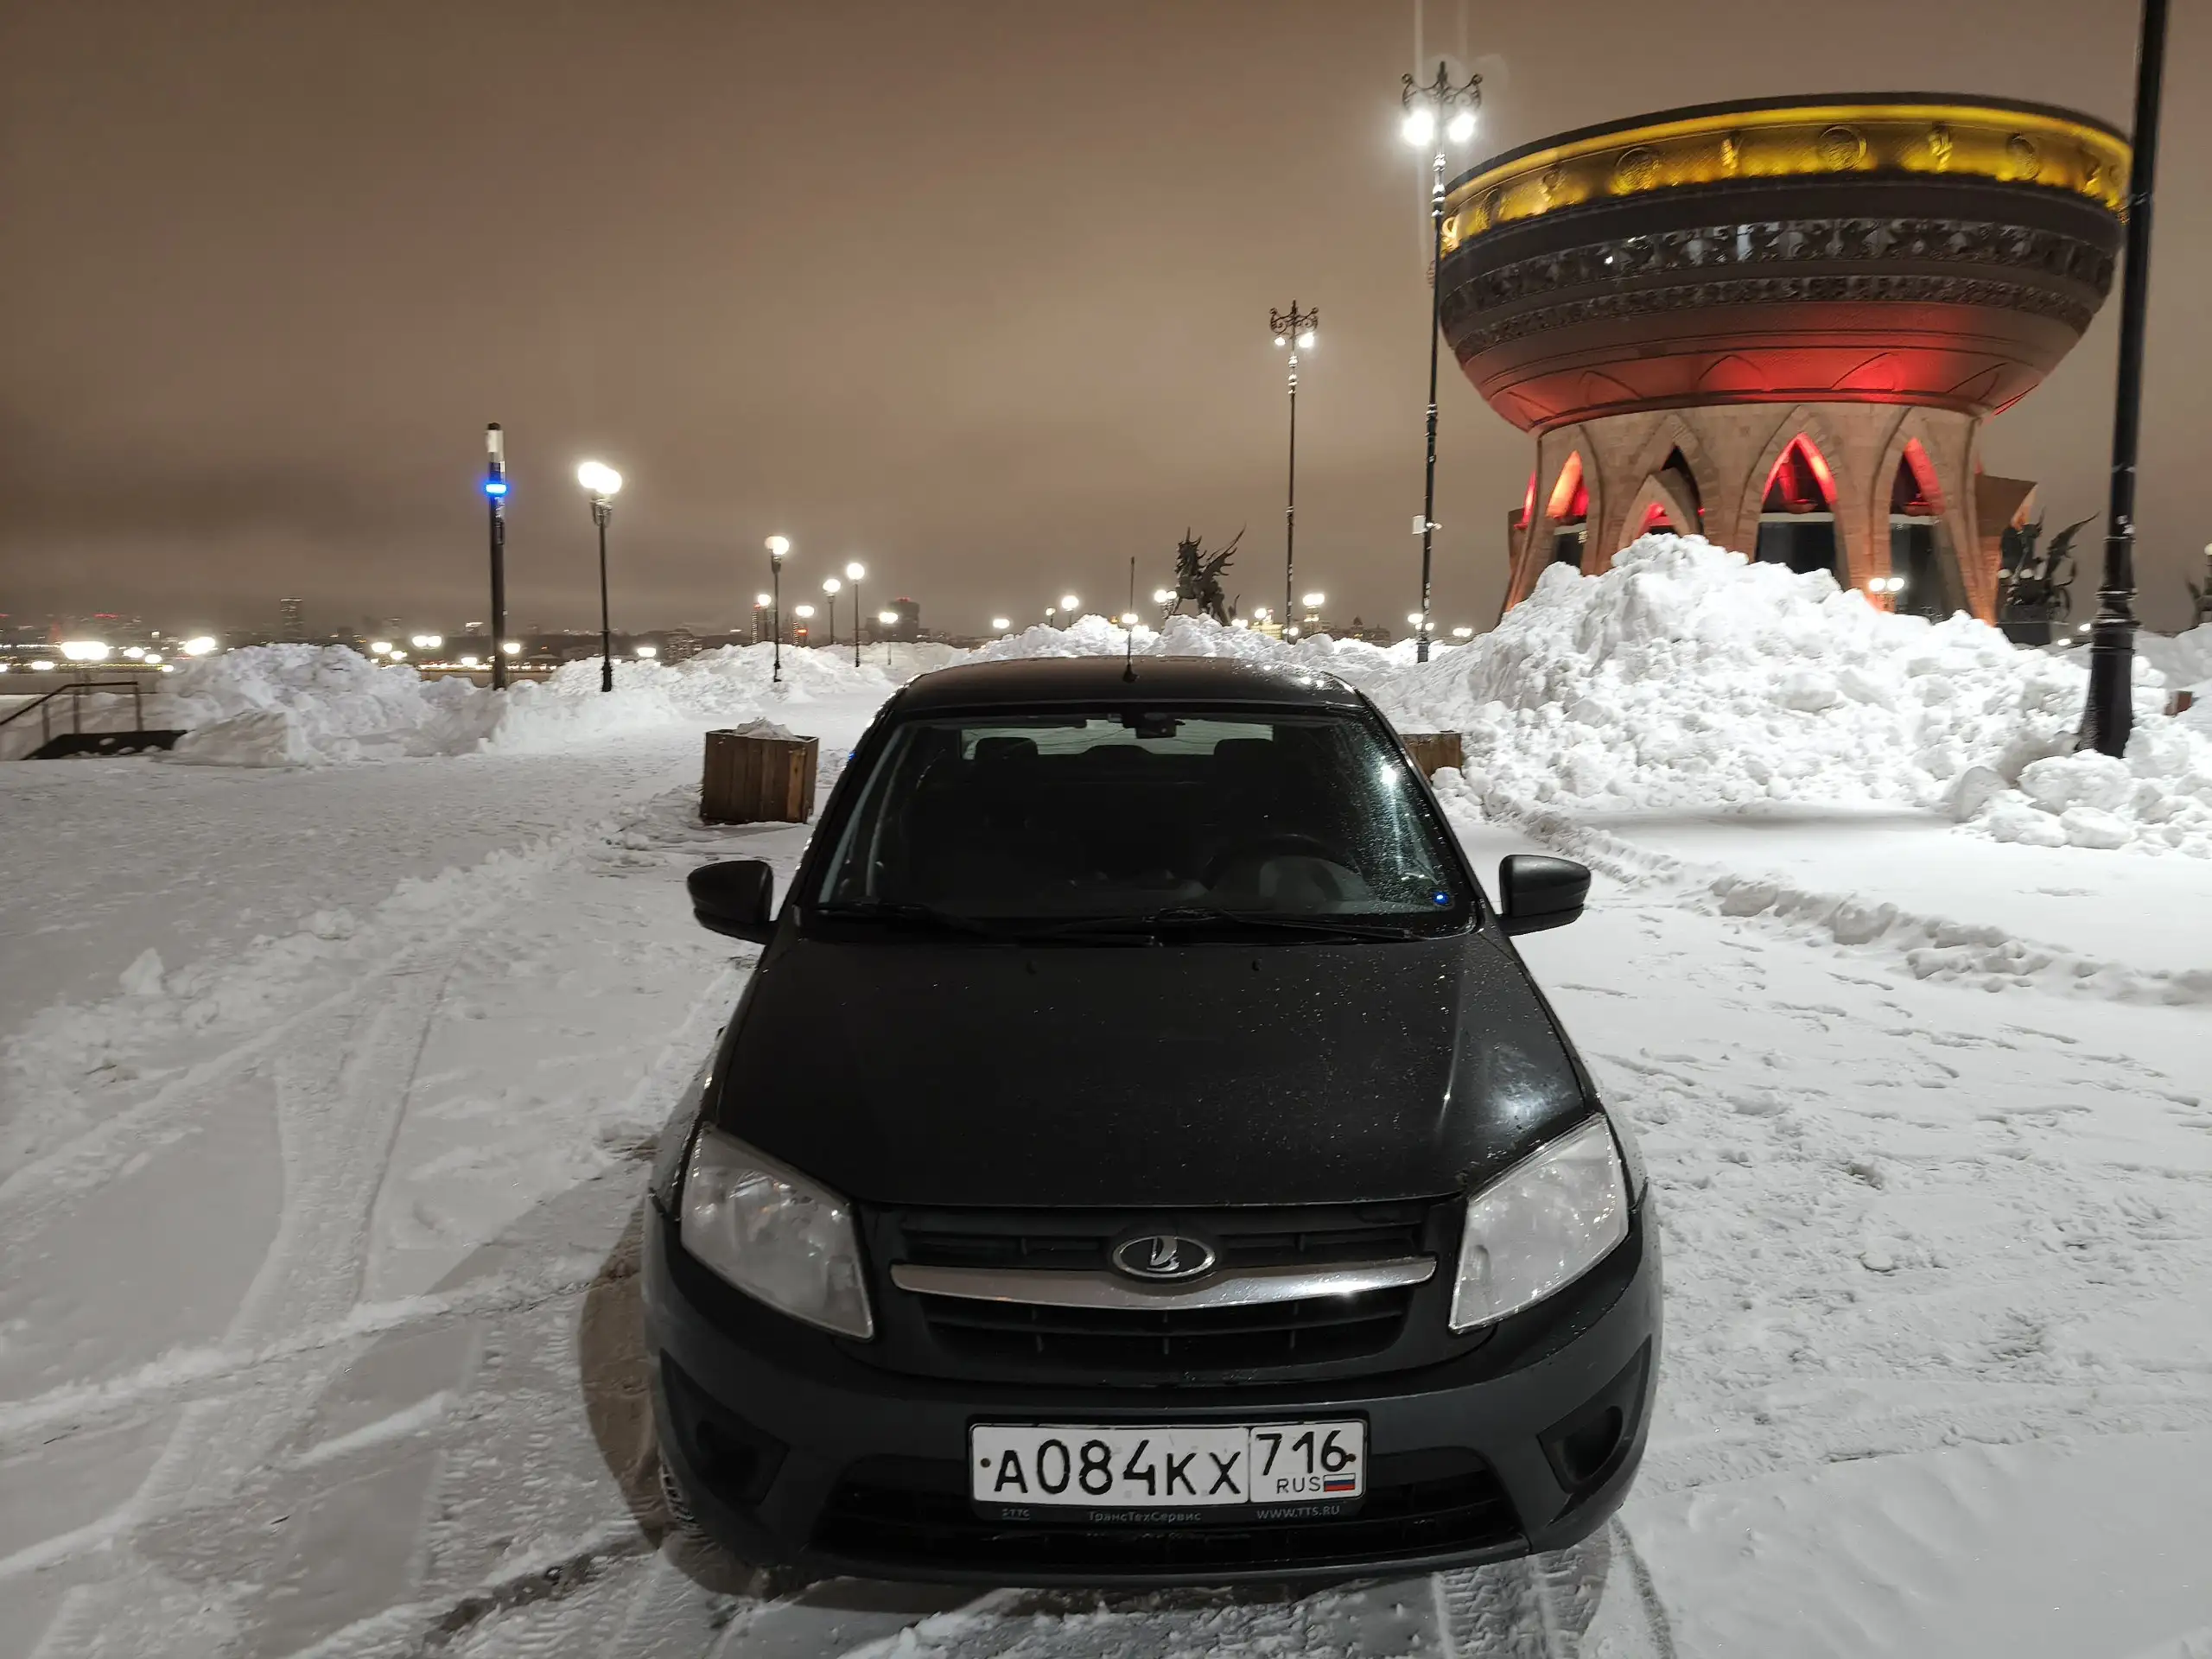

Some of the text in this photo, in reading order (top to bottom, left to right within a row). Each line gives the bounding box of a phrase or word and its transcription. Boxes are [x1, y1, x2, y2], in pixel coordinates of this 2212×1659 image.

[994, 1430, 1347, 1496] А084КХ 716
[1276, 1476, 1321, 1494] RUS
[1089, 1511, 1201, 1522] ТрансТехСервис
[1257, 1505, 1339, 1519] WWW.TTS.RU
